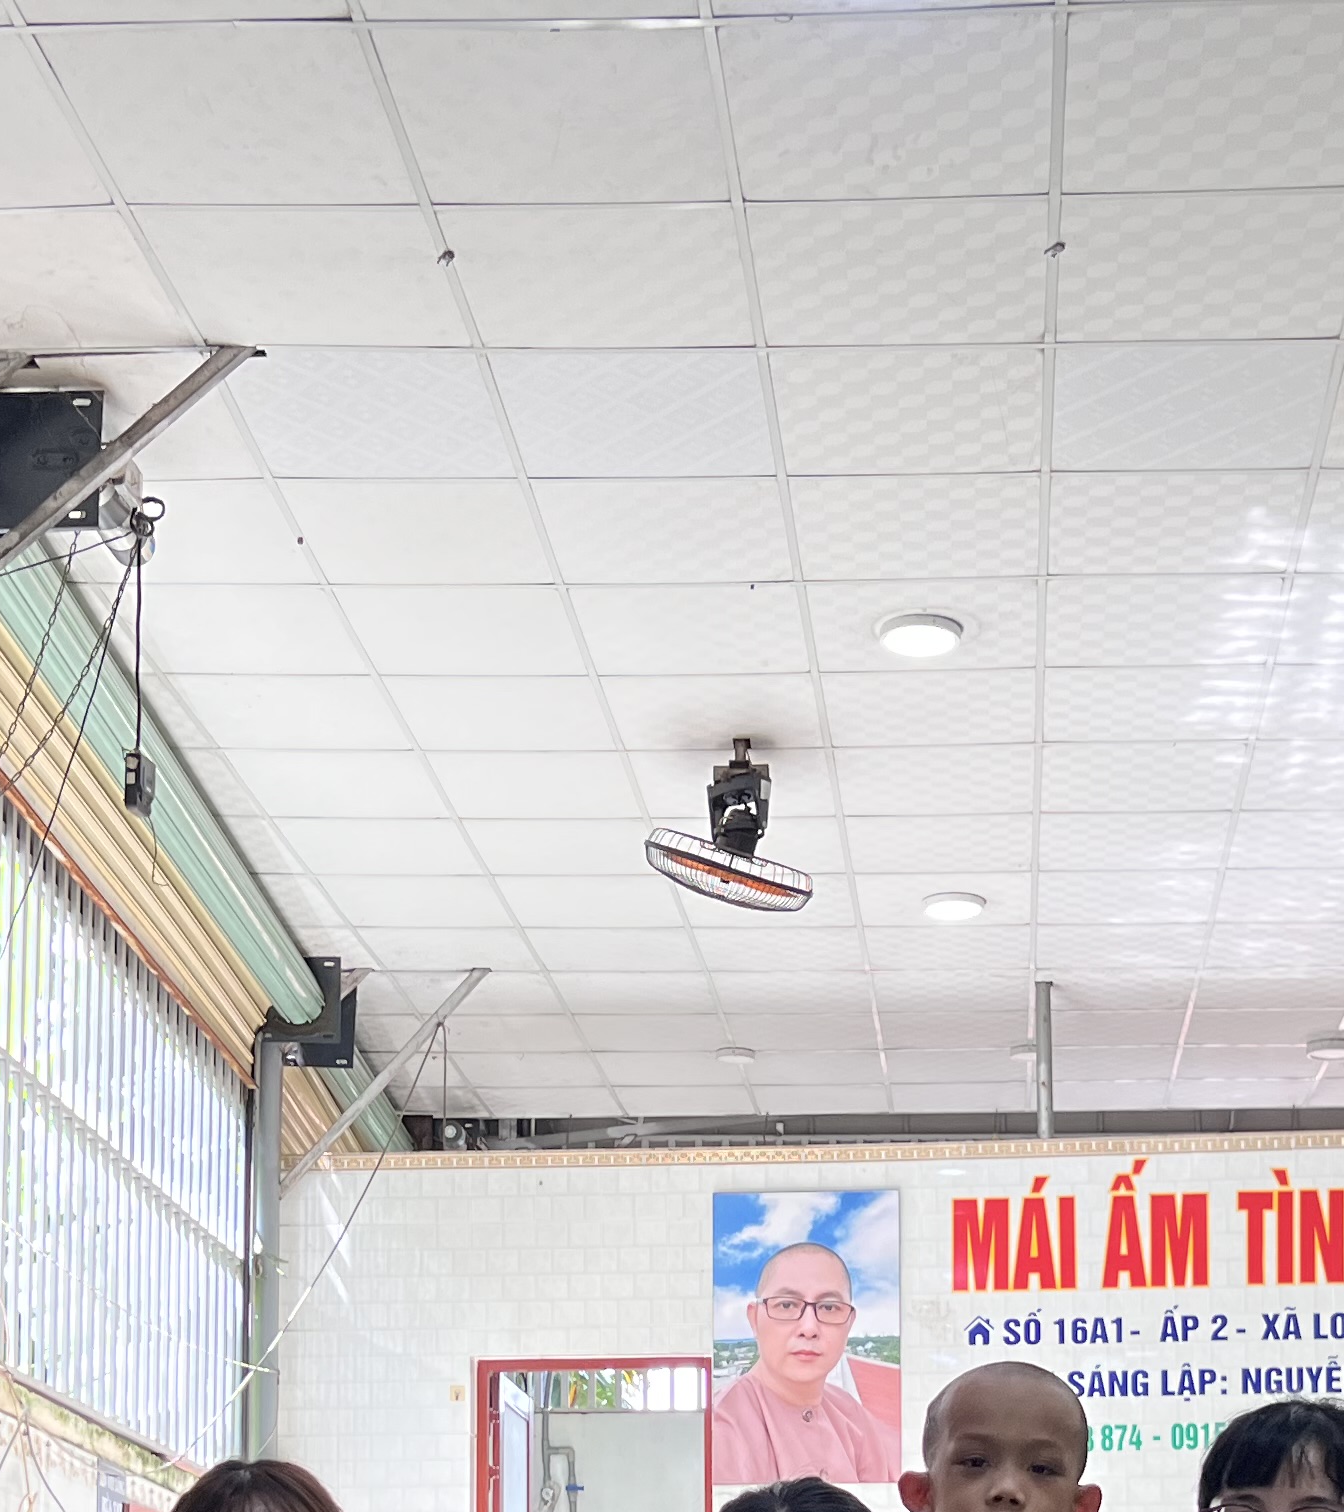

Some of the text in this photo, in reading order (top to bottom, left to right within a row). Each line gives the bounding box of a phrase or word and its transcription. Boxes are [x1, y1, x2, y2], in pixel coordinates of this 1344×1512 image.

[952, 1174, 1078, 1292] MÁI
[1101, 1157, 1210, 1289] ẤM
[1002, 1308, 1043, 1346] SỐ
[1160, 1304, 1199, 1342] ẤP
[1261, 1306, 1303, 1341] XÃ
[1067, 1364, 1149, 1398] SÁNG
[1161, 1363, 1228, 1401] LẬP:
[1101, 1423, 1143, 1451] 874
